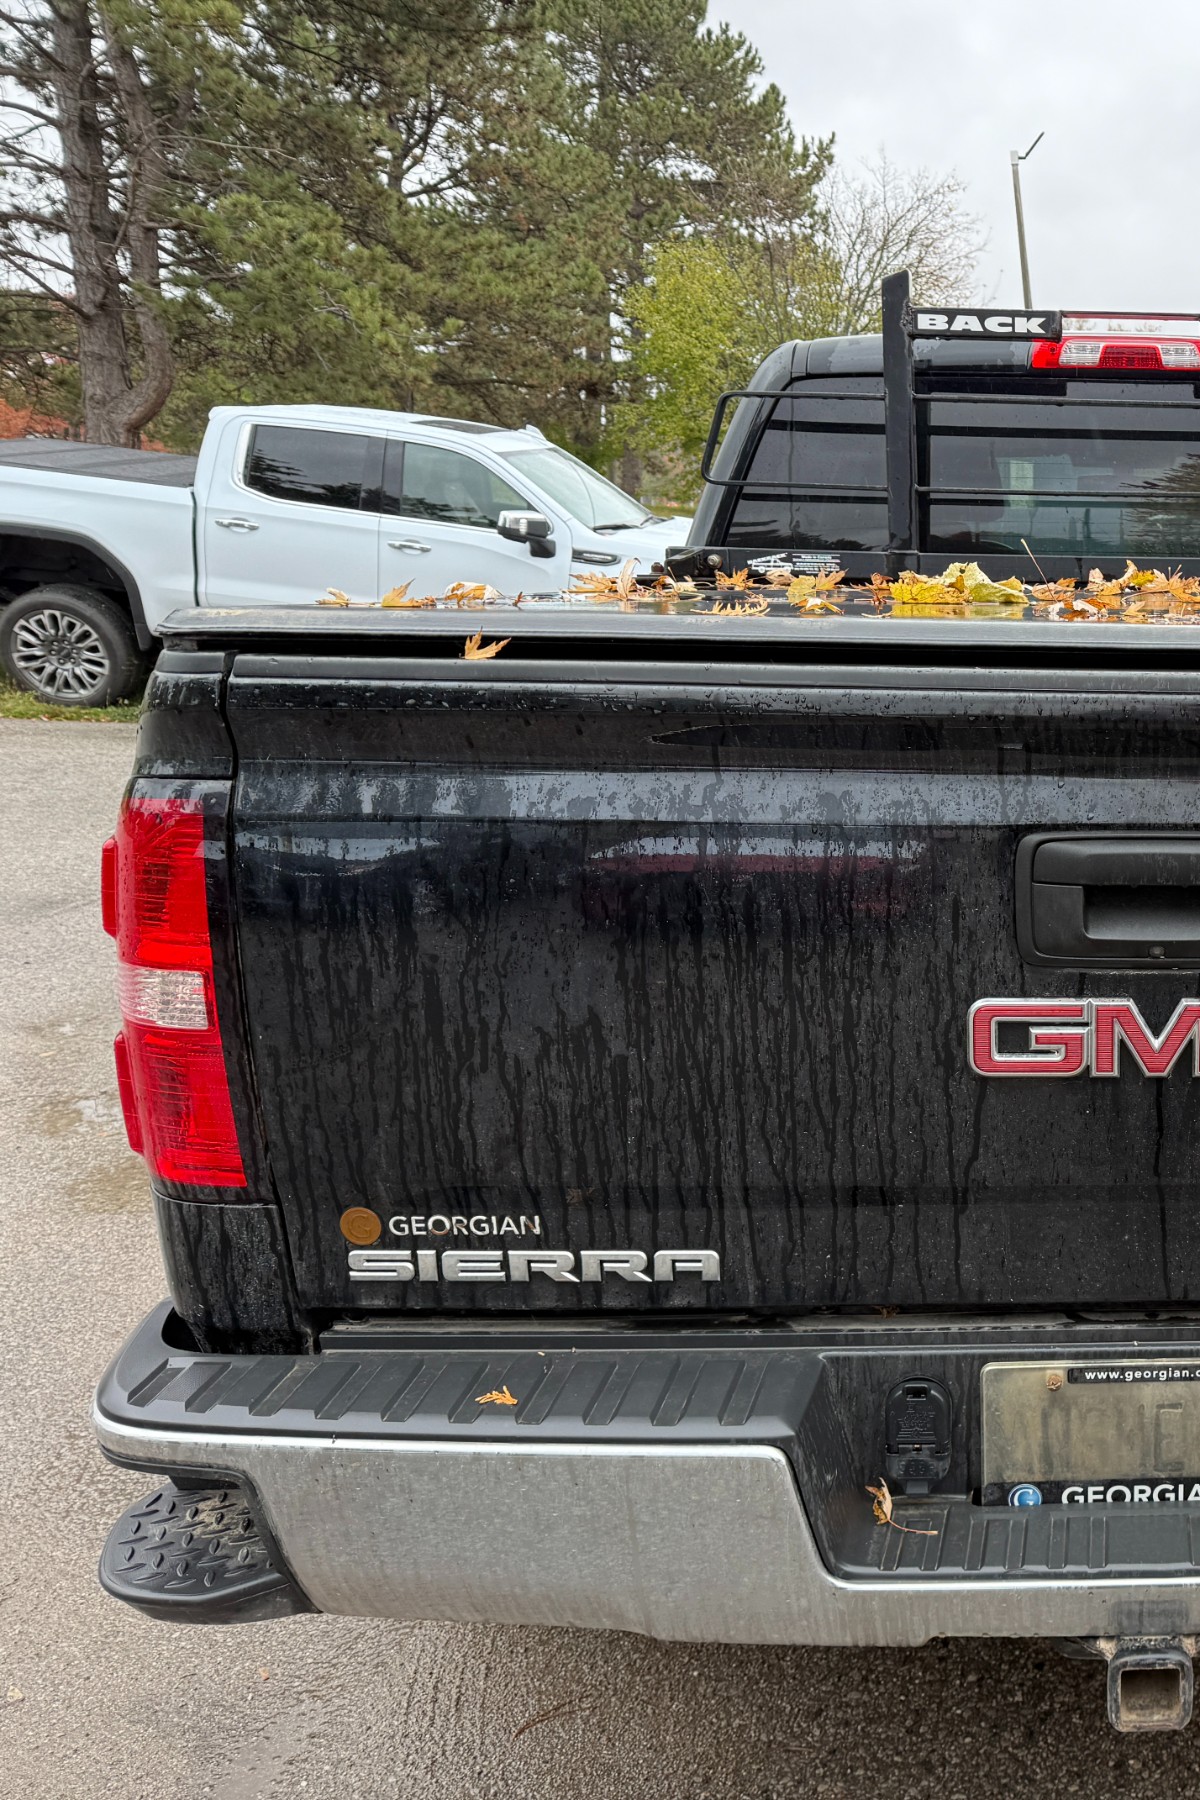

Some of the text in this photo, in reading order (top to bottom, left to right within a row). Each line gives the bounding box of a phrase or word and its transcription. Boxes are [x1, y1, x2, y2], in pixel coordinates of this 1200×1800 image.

[917, 314, 1047, 333] BACK
[388, 1215, 541, 1236] GEORGIAN
[347, 1249, 721, 1283] SIERRA
